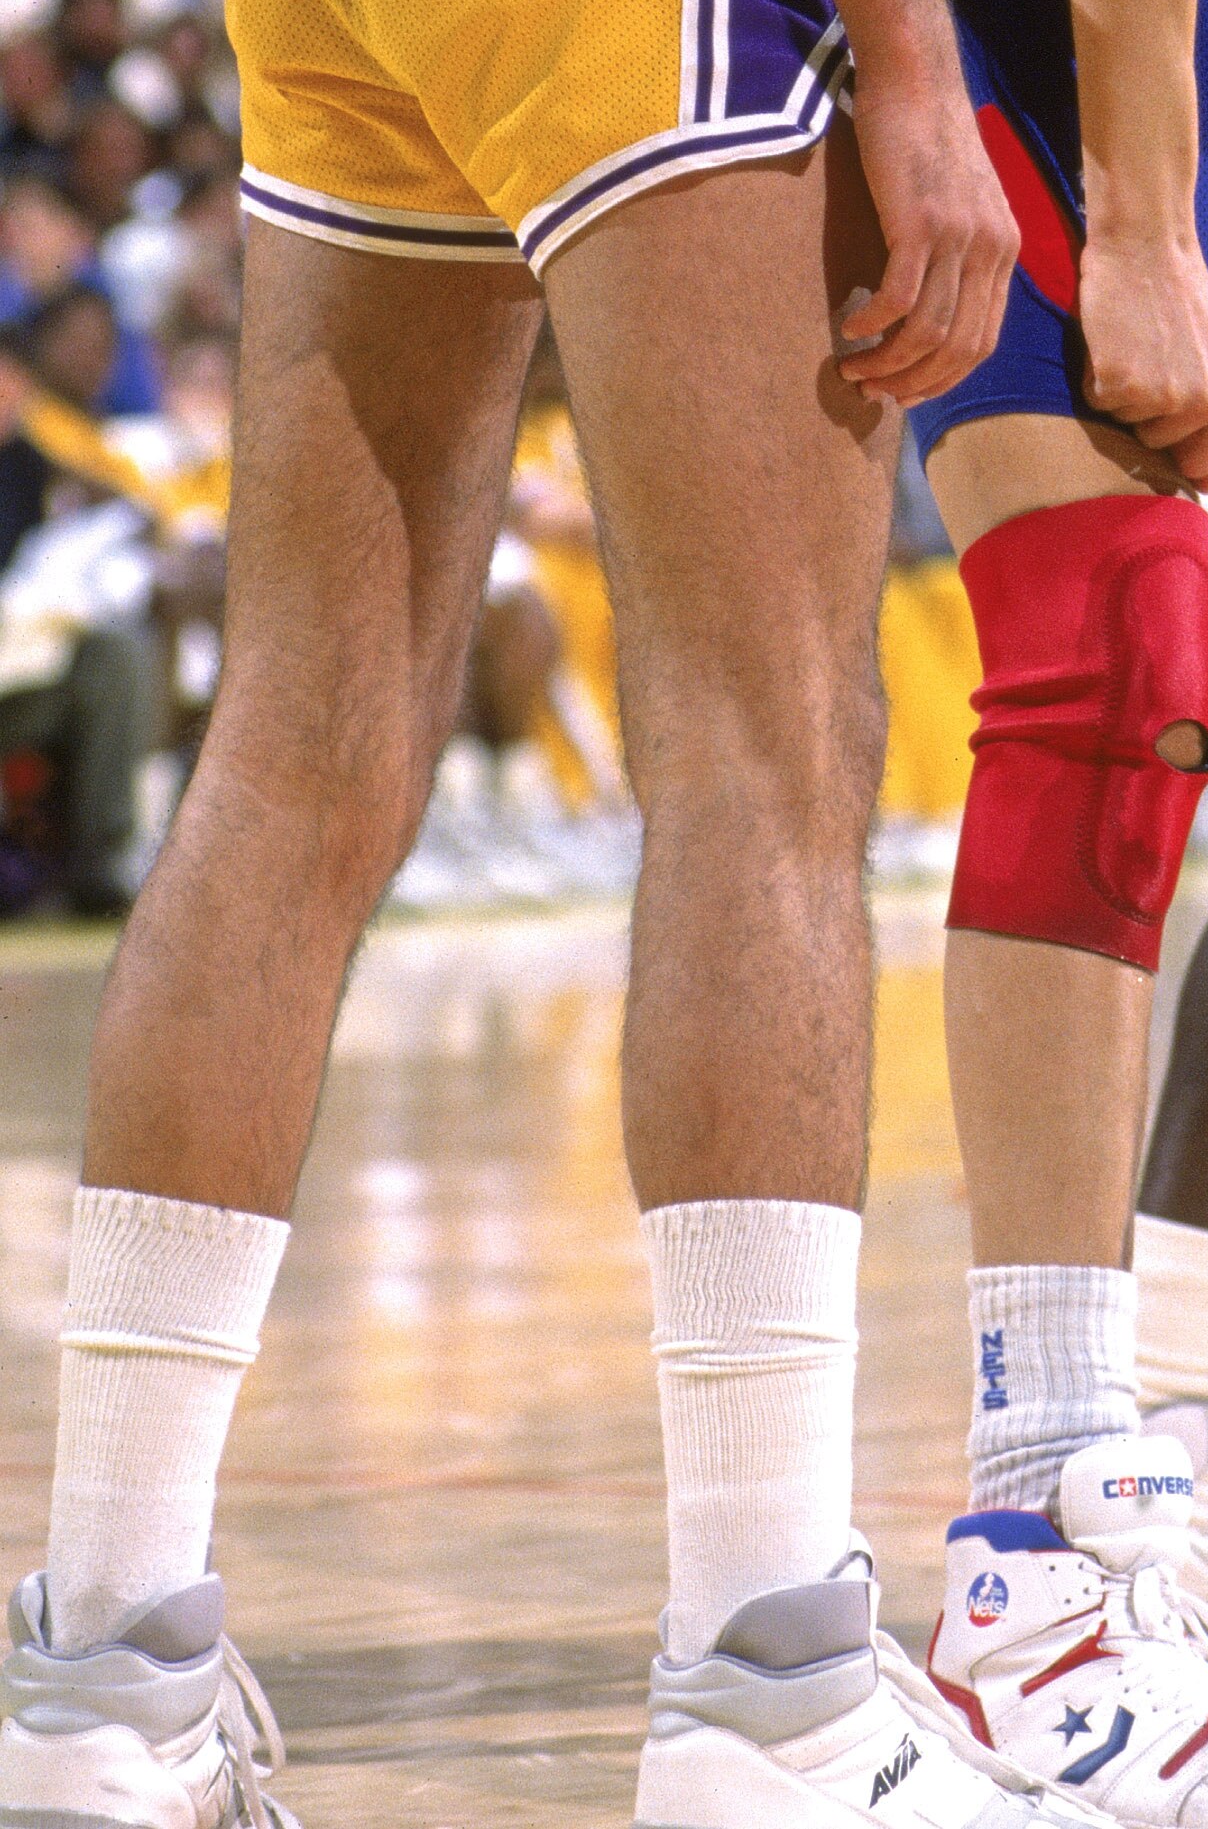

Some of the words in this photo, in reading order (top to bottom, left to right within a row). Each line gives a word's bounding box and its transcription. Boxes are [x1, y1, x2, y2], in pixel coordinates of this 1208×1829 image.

[980, 1328, 1010, 1411] NETS
[1102, 1475, 1194, 1500] CONVERS
[868, 1732, 922, 1810] AVIA
